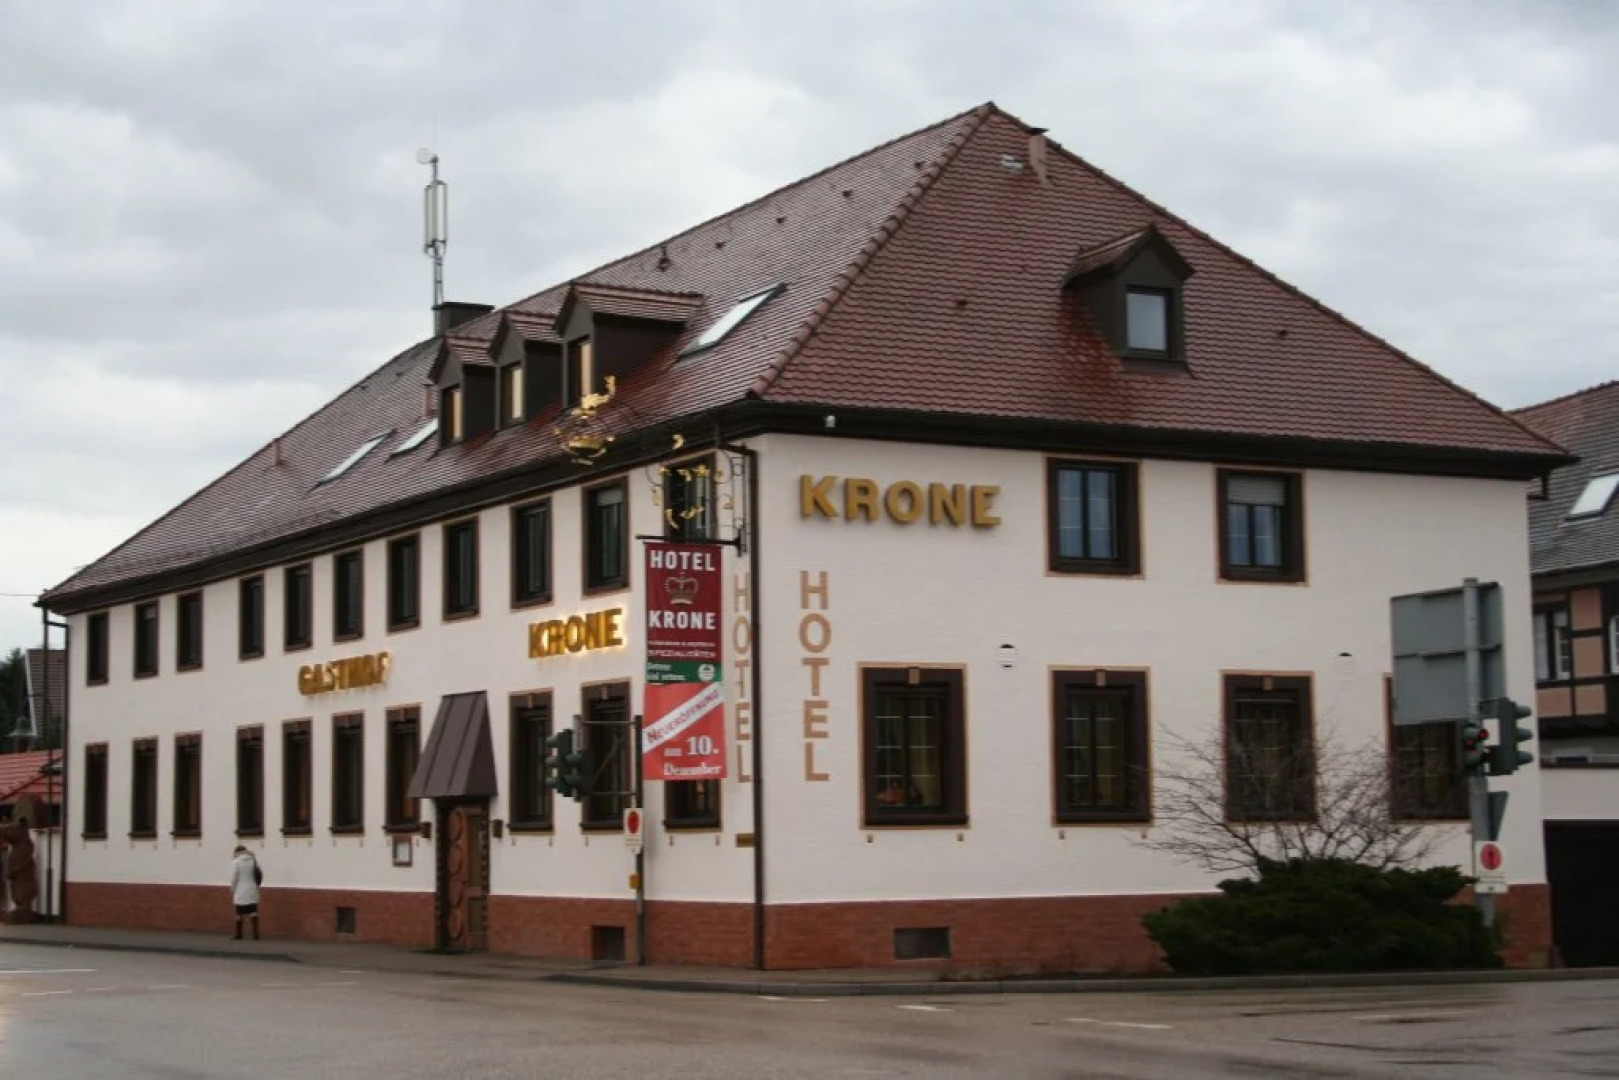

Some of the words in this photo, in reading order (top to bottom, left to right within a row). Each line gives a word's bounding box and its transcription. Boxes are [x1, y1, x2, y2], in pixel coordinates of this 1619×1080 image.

[799, 474, 1002, 526] KRONE
[650, 549, 716, 571] HOTEL
[528, 608, 623, 658] KRONE
[648, 609, 716, 630] KRONE
[732, 573, 752, 783] HOTEL
[798, 570, 832, 782] HOTEL
[687, 735, 719, 756] 10.
